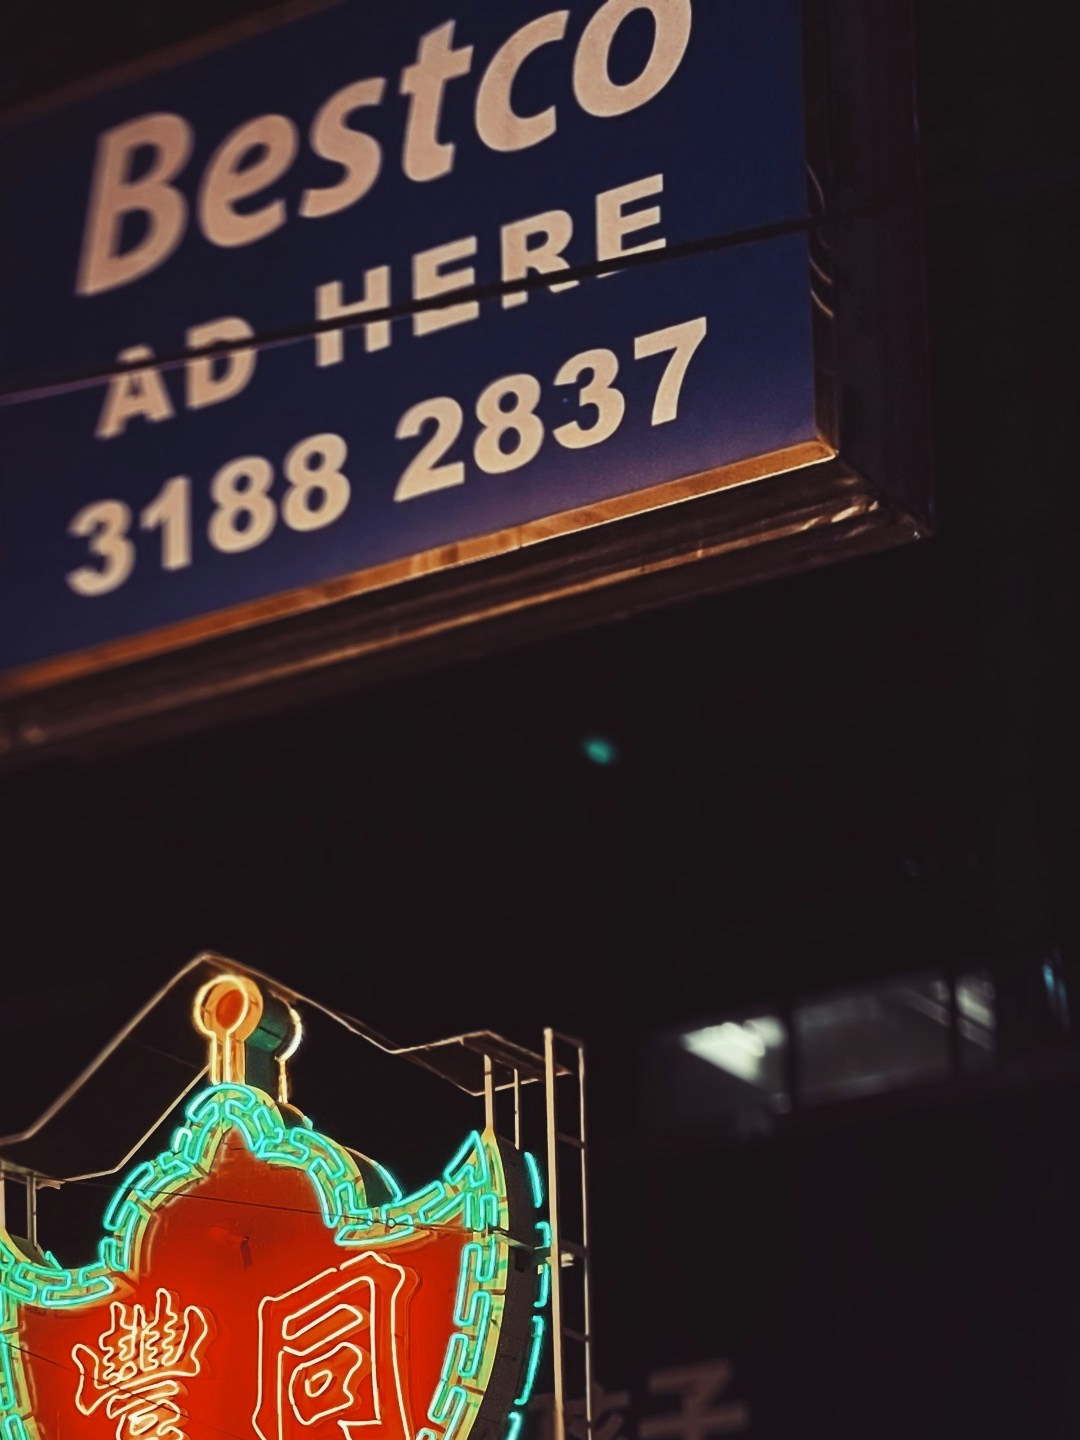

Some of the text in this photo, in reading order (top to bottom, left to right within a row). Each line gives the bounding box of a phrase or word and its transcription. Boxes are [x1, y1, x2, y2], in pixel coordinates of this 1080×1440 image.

[76, 0, 692, 296] Bestco
[95, 173, 669, 440] AD HERE
[66, 316, 708, 596] 3188 2837
